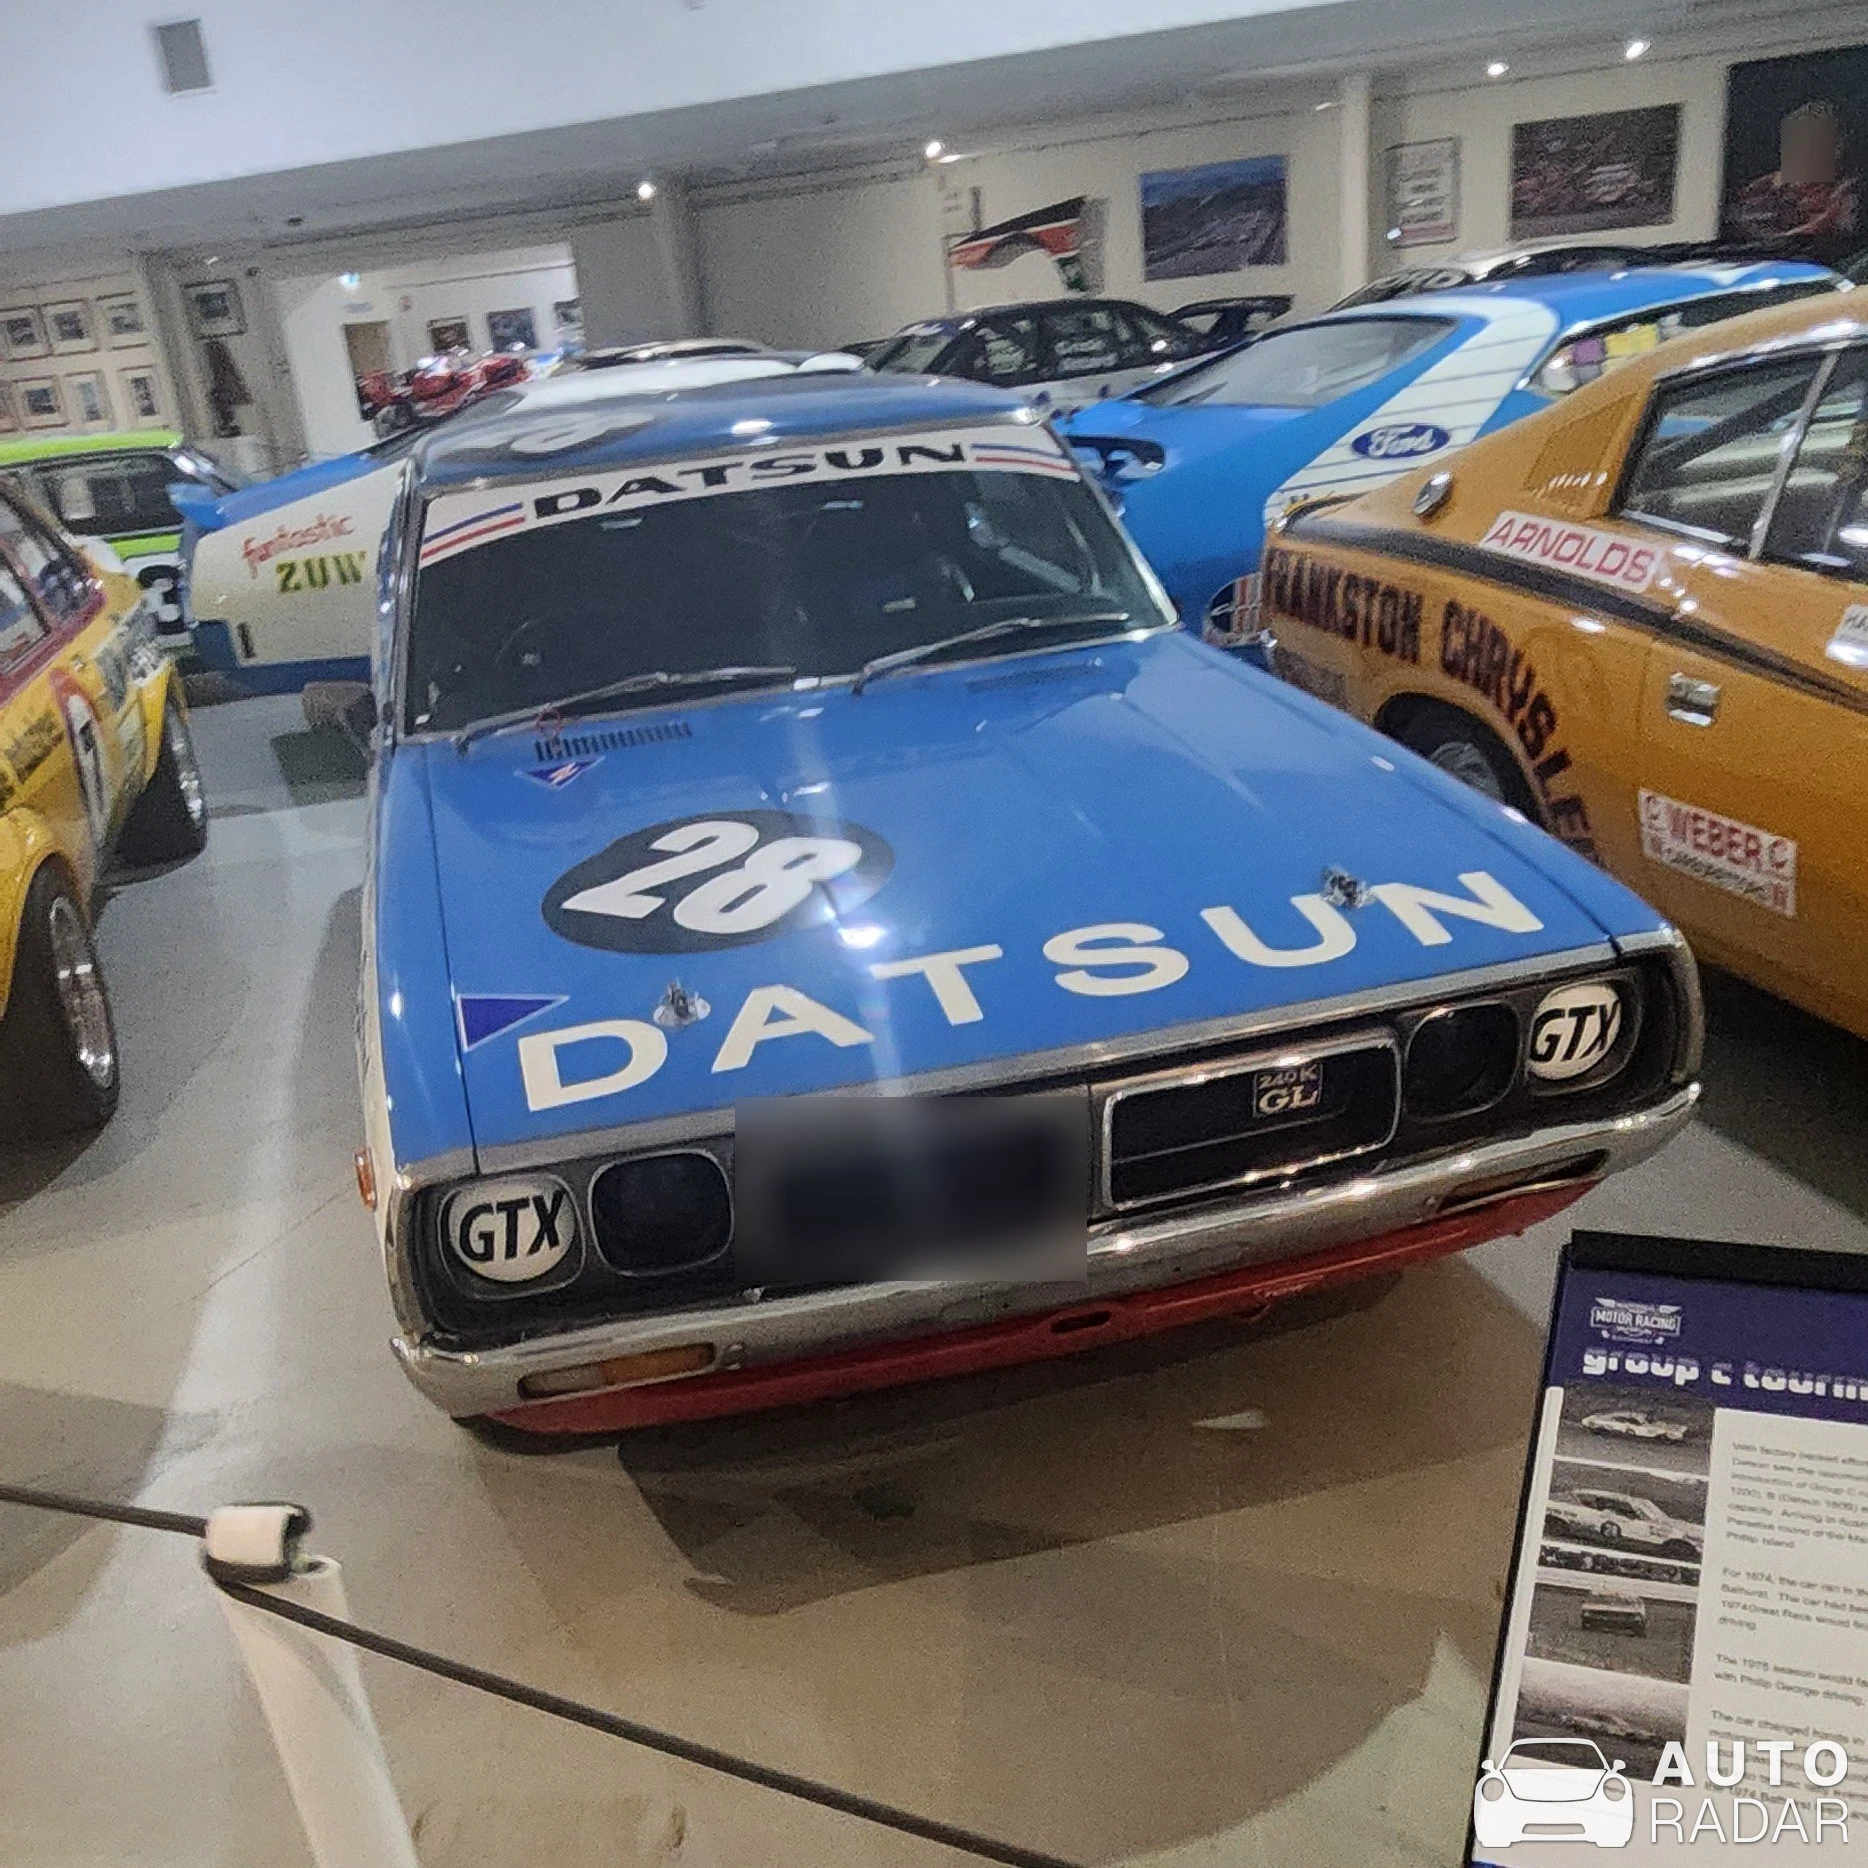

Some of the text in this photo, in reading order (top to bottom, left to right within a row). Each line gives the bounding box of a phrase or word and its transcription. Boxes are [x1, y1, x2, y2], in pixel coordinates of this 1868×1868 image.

[1368, 424, 1435, 456] Ford
[533, 442, 968, 520] DATSUN
[1484, 517, 1656, 584] ARNOLDS
[1667, 803, 1763, 875] WEBER
[561, 819, 863, 935] 28
[517, 870, 1546, 1112] DATSUN
[1529, 999, 1620, 1063] GTX
[1258, 1085, 1319, 1115] GL
[459, 1187, 567, 1263] GTX
[1595, 1309, 1677, 1331] MOTOR RACING
[1583, 1348, 1700, 1386] group
